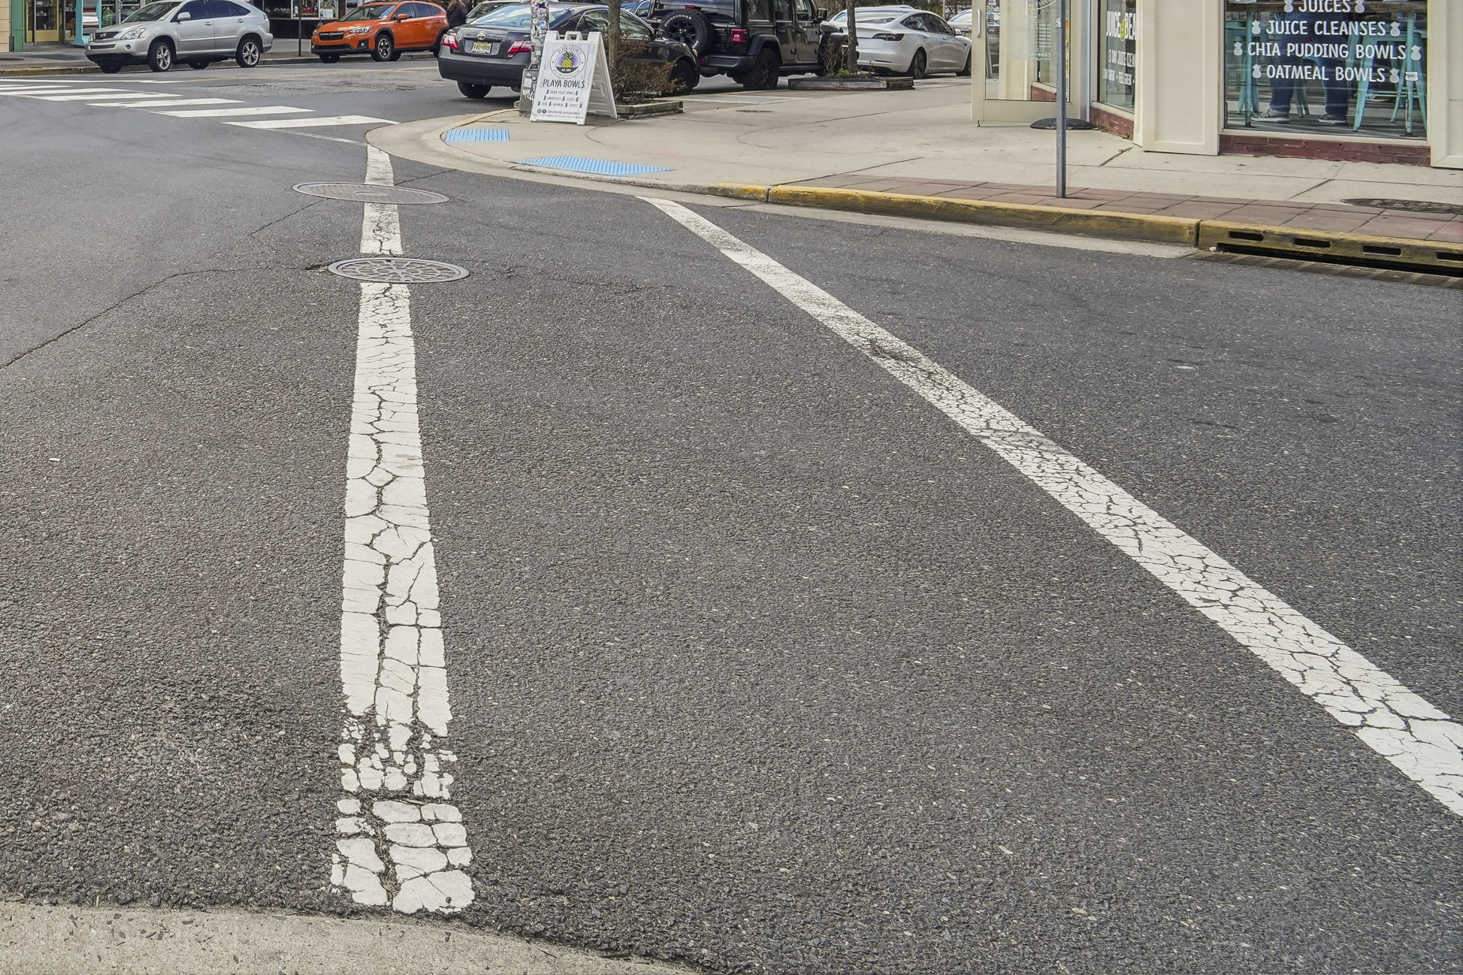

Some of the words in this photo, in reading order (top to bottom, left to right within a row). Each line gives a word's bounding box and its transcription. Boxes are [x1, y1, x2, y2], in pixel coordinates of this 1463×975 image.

[1265, 21, 1308, 35] JUICE
[1314, 21, 1386, 36] CLEANSES
[1248, 42, 1281, 57] CHIA
[1287, 43, 1349, 58] PUDDING
[1356, 44, 1406, 60] BOWLS
[1266, 65, 1329, 80] OATMEAL
[1336, 66, 1385, 82] BOWLS
[543, 79, 562, 88] PLAYA
[563, 80, 585, 89] BOWLS
